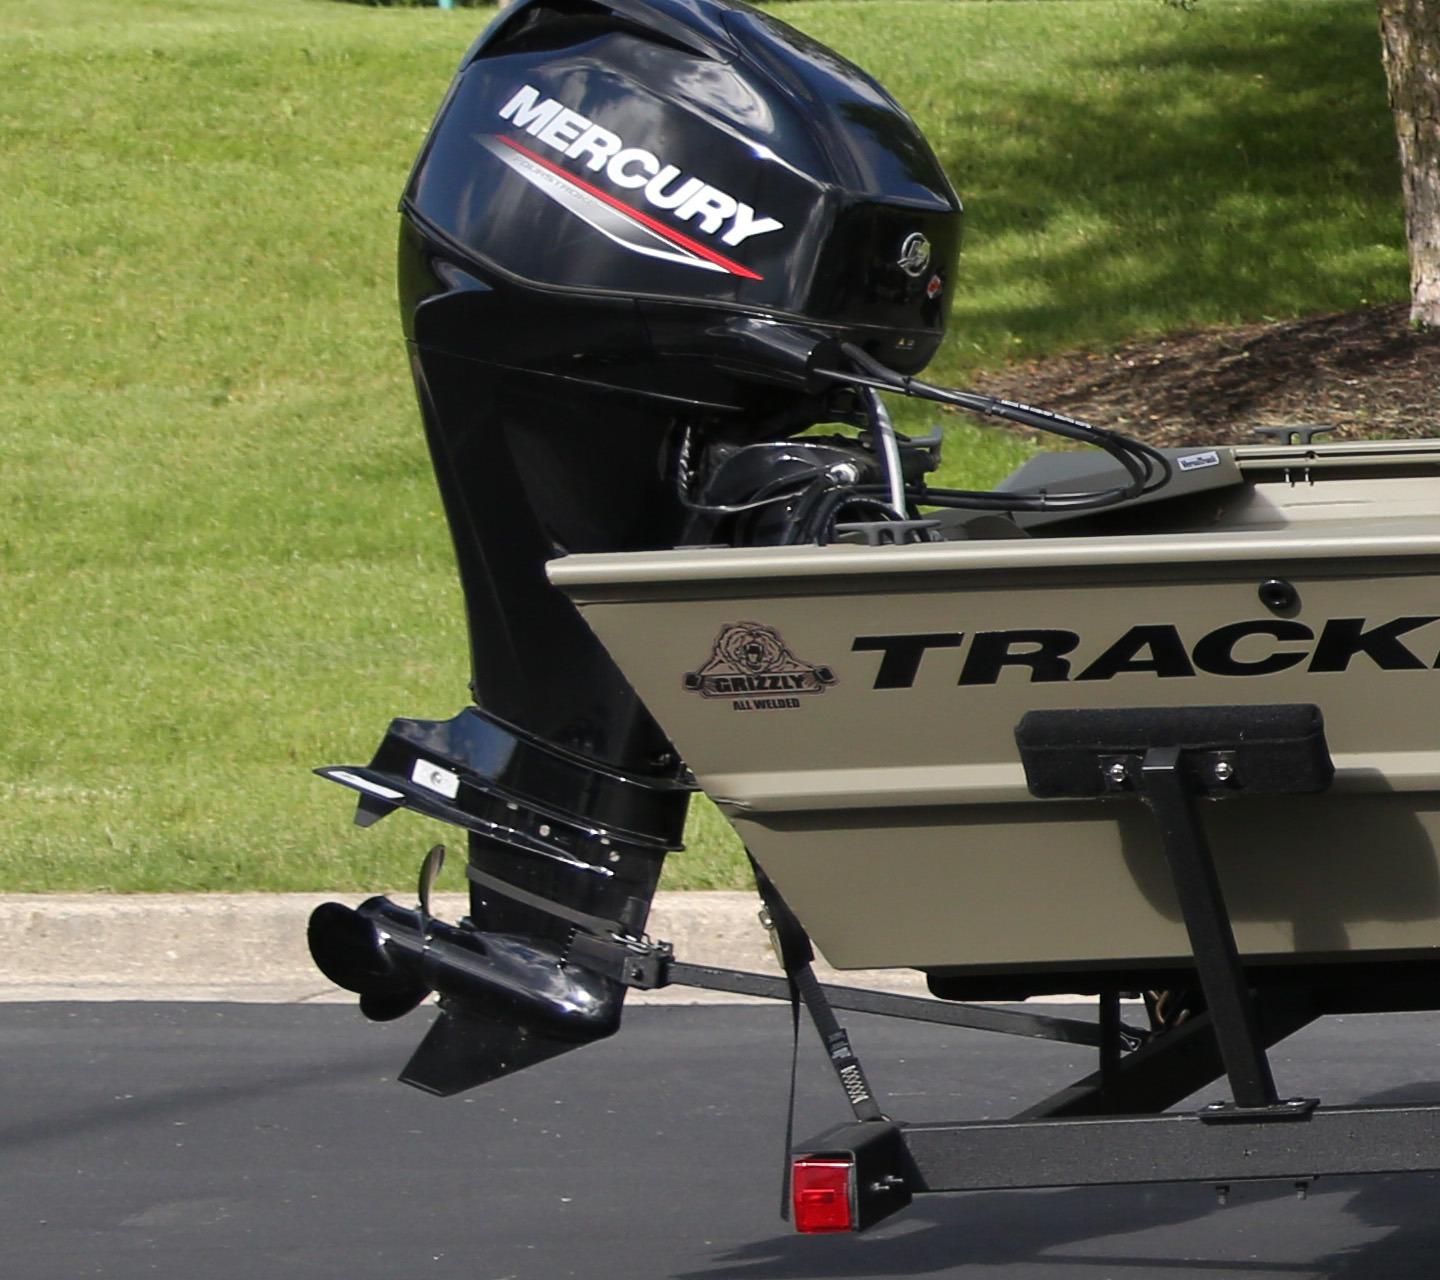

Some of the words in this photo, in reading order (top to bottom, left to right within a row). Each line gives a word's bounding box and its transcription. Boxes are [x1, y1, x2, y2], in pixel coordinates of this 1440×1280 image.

[499, 85, 784, 246] MERCURY
[714, 674, 804, 692] GRIZZLY
[733, 700, 752, 711] ALL
[753, 698, 800, 710] WELDED
